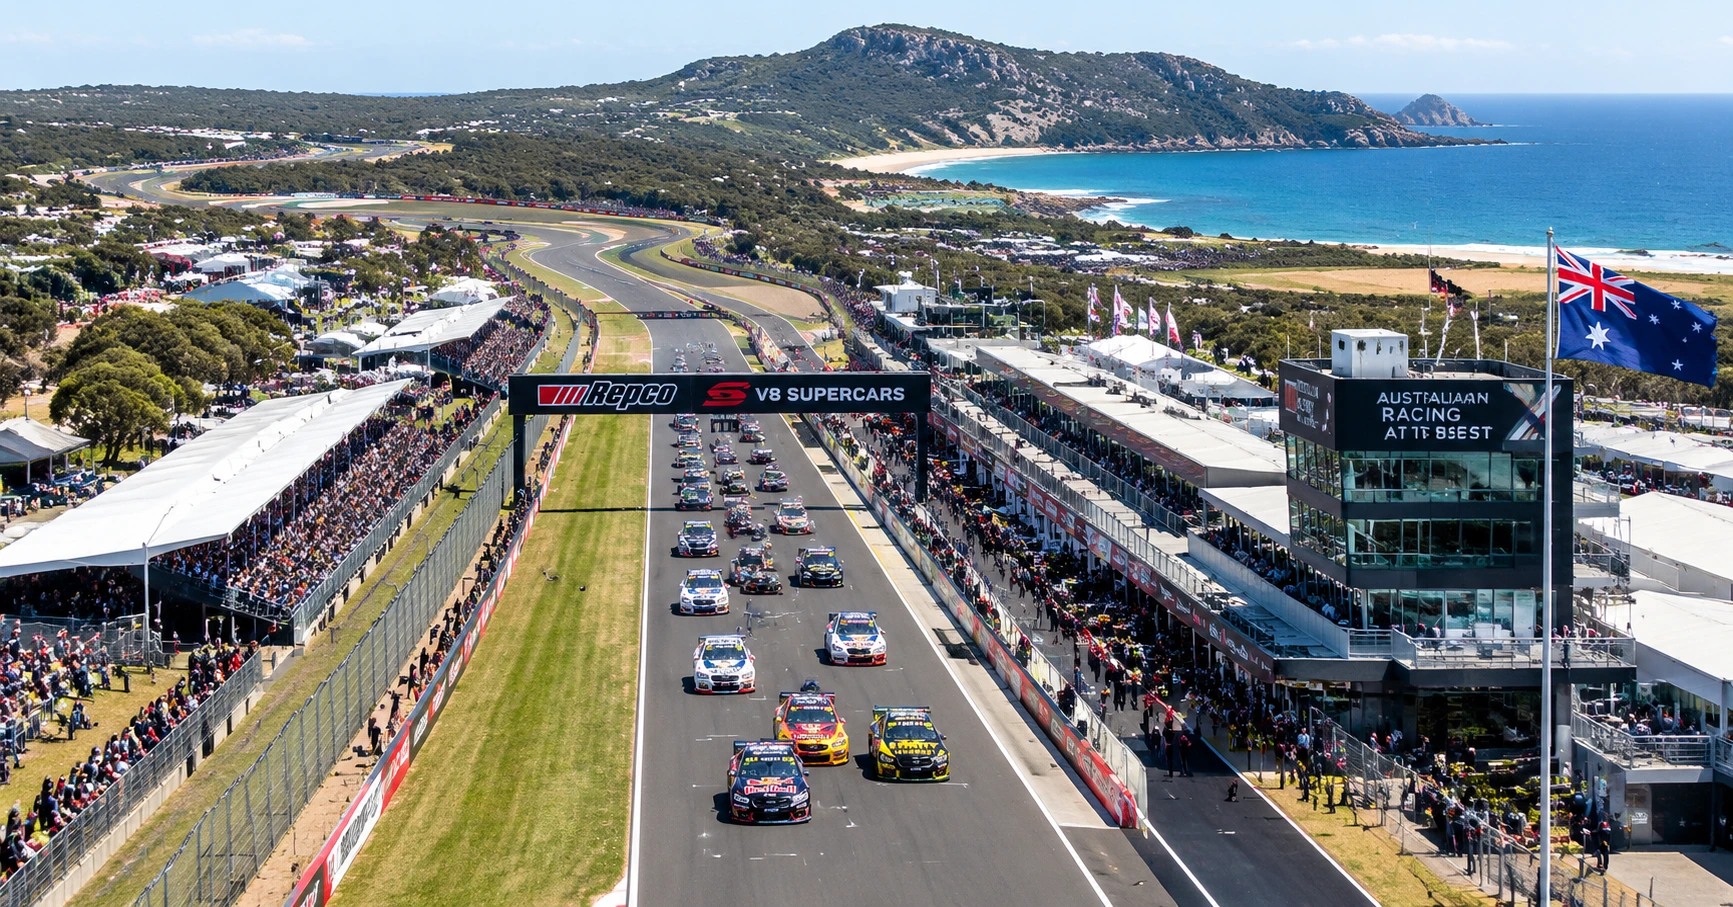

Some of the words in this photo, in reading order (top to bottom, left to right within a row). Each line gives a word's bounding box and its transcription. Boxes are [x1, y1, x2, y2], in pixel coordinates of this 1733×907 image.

[583, 380, 678, 411] Repco
[755, 387, 781, 402] V8
[787, 387, 905, 402] SUPERCARS
[1382, 407, 1461, 422] RACING
